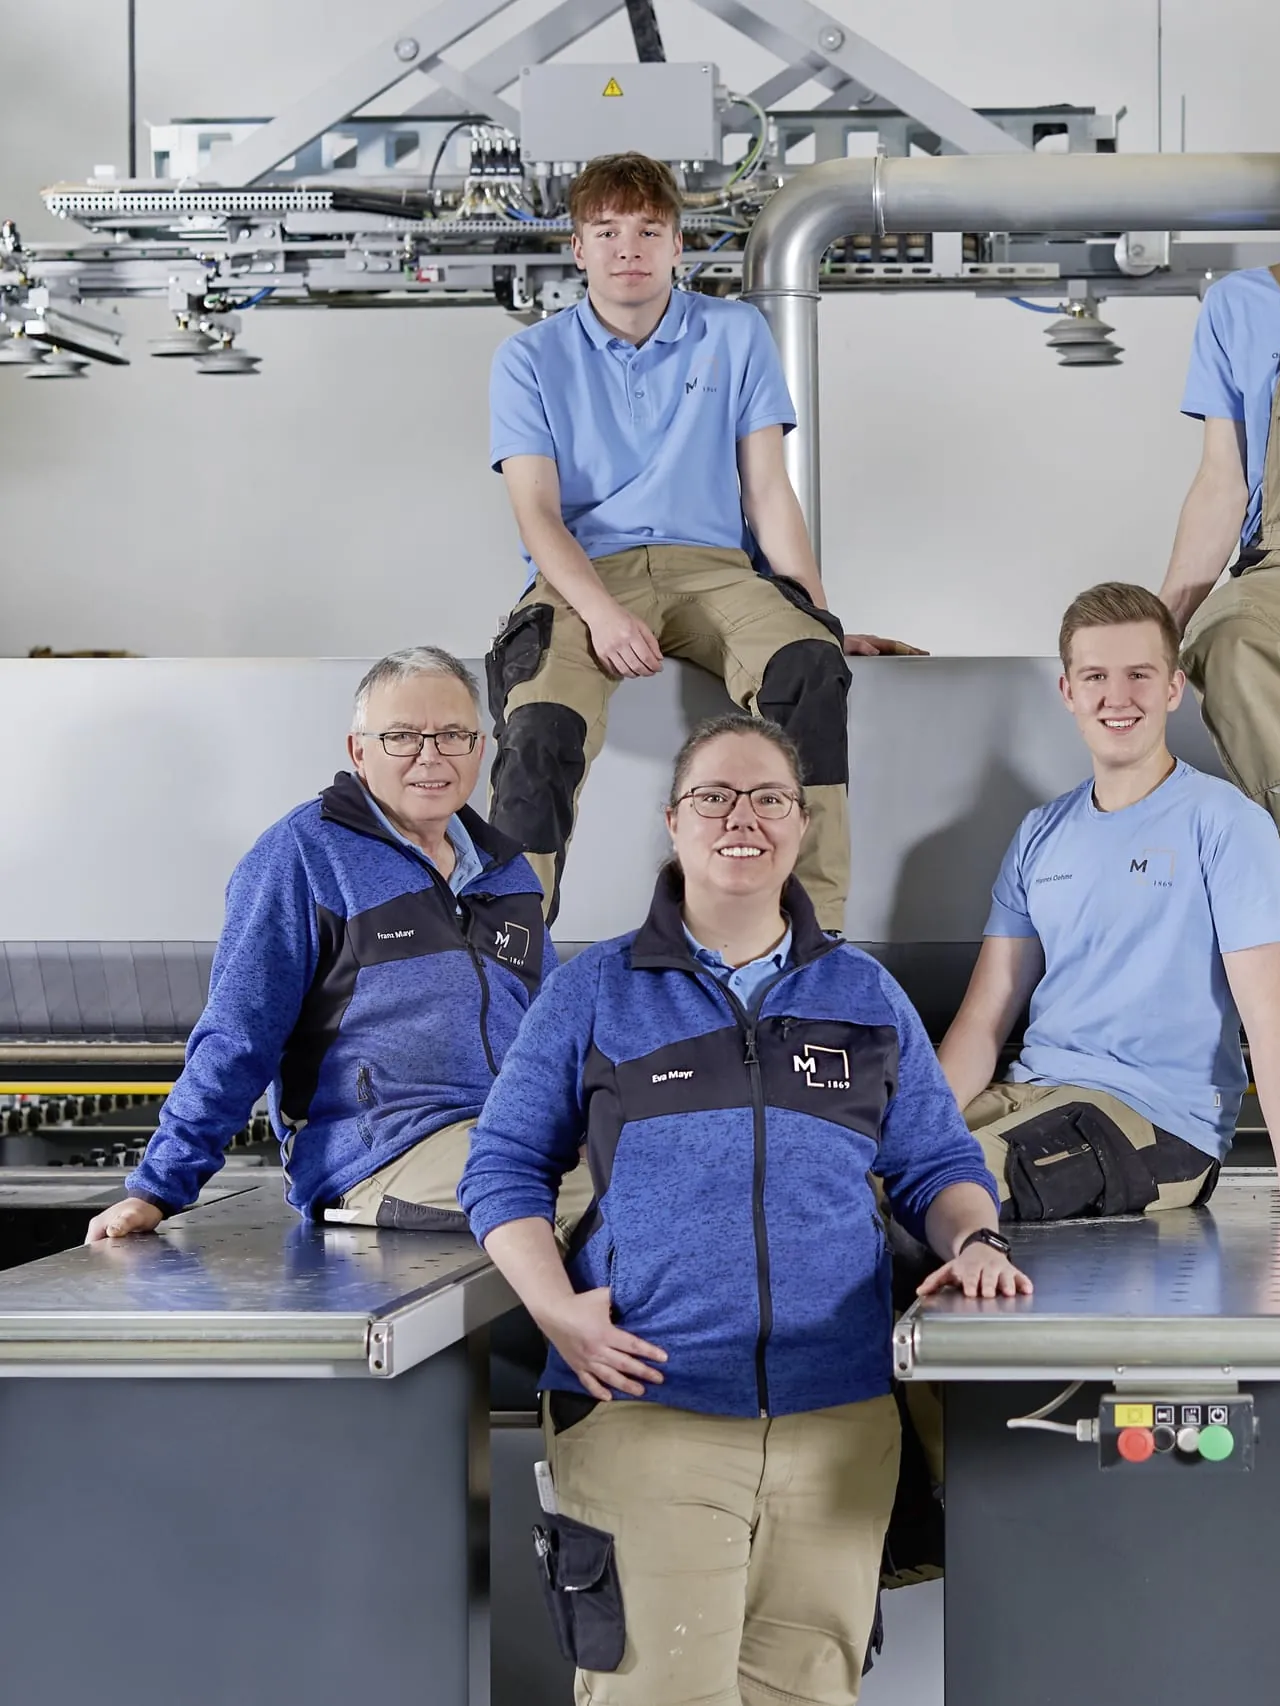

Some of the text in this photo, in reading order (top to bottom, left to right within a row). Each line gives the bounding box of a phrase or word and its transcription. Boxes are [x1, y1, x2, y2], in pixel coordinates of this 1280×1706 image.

[1129, 858, 1148, 873] M
[377, 929, 414, 940] Franz Mayr
[494, 931, 511, 948] M
[793, 1055, 817, 1074] M
[652, 1069, 694, 1084] Eva Mayr
[827, 1080, 850, 1089] 1869
